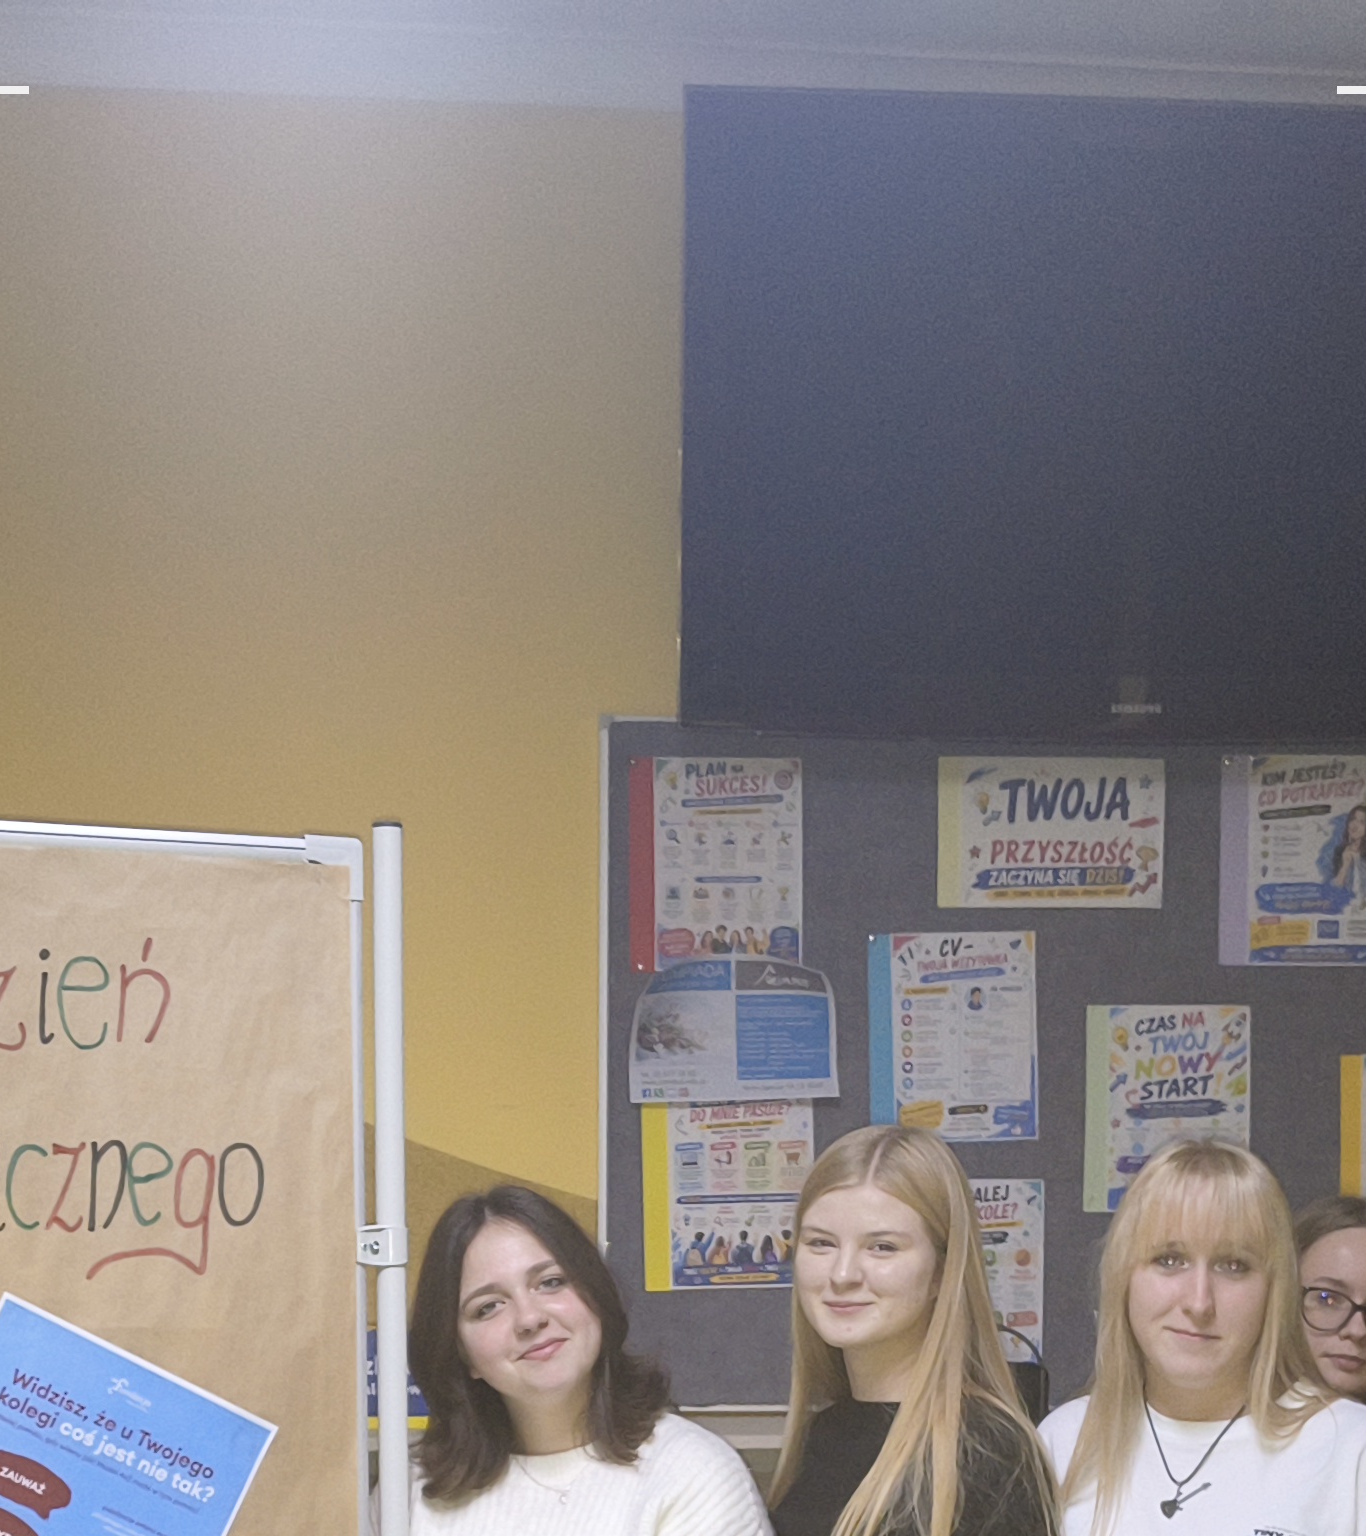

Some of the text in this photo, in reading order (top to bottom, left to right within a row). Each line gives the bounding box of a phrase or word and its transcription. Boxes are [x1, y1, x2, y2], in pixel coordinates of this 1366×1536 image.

[685, 762, 727, 779] PLAN
[695, 775, 768, 797] SUKCES!
[999, 776, 1130, 824] TWOJA
[990, 836, 1134, 865] PRZYSZŁOŚĆ
[988, 869, 1054, 886] ZACZYNA
[1135, 1011, 1205, 1036] CZAS NA
[1135, 1051, 1224, 1080] NOWY
[1139, 1071, 1224, 1100] START!
[974, 1184, 1009, 1203] ALEJ
[13, 1368, 88, 1422] Widzisz,
[93, 1411, 117, 1432] że
[121, 1426, 133, 1440] u
[138, 1429, 214, 1479] Twojego
[59, 1421, 94, 1447] coś
[95, 1436, 137, 1467] jest
[137, 1456, 168, 1482] nie
[171, 1472, 216, 1503] tak?
